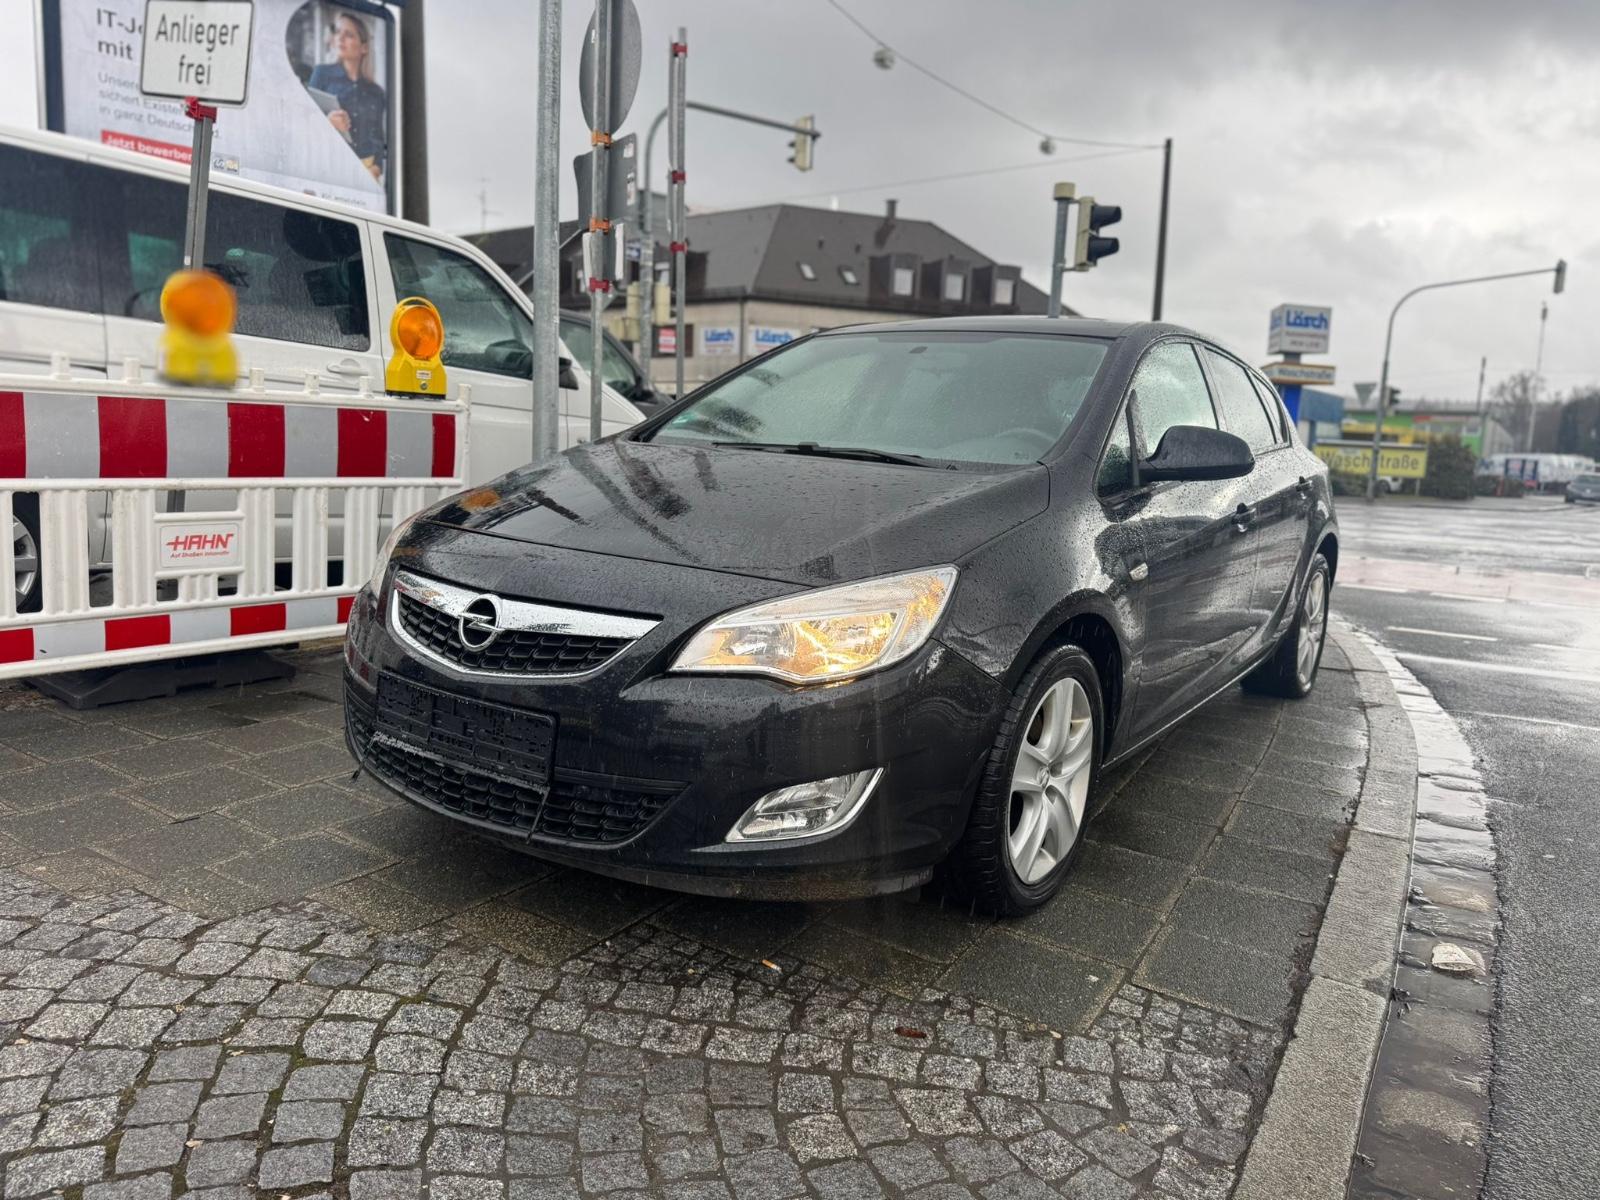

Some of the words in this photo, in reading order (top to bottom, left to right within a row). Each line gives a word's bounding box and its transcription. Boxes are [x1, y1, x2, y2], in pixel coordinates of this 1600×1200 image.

[155, 13, 240, 53] Anlieger
[98, 40, 133, 60] mit
[178, 54, 212, 86] frei
[104, 135, 136, 151] Jetzt
[1319, 450, 1419, 470] Waschtraße
[166, 533, 234, 551] HAHN
